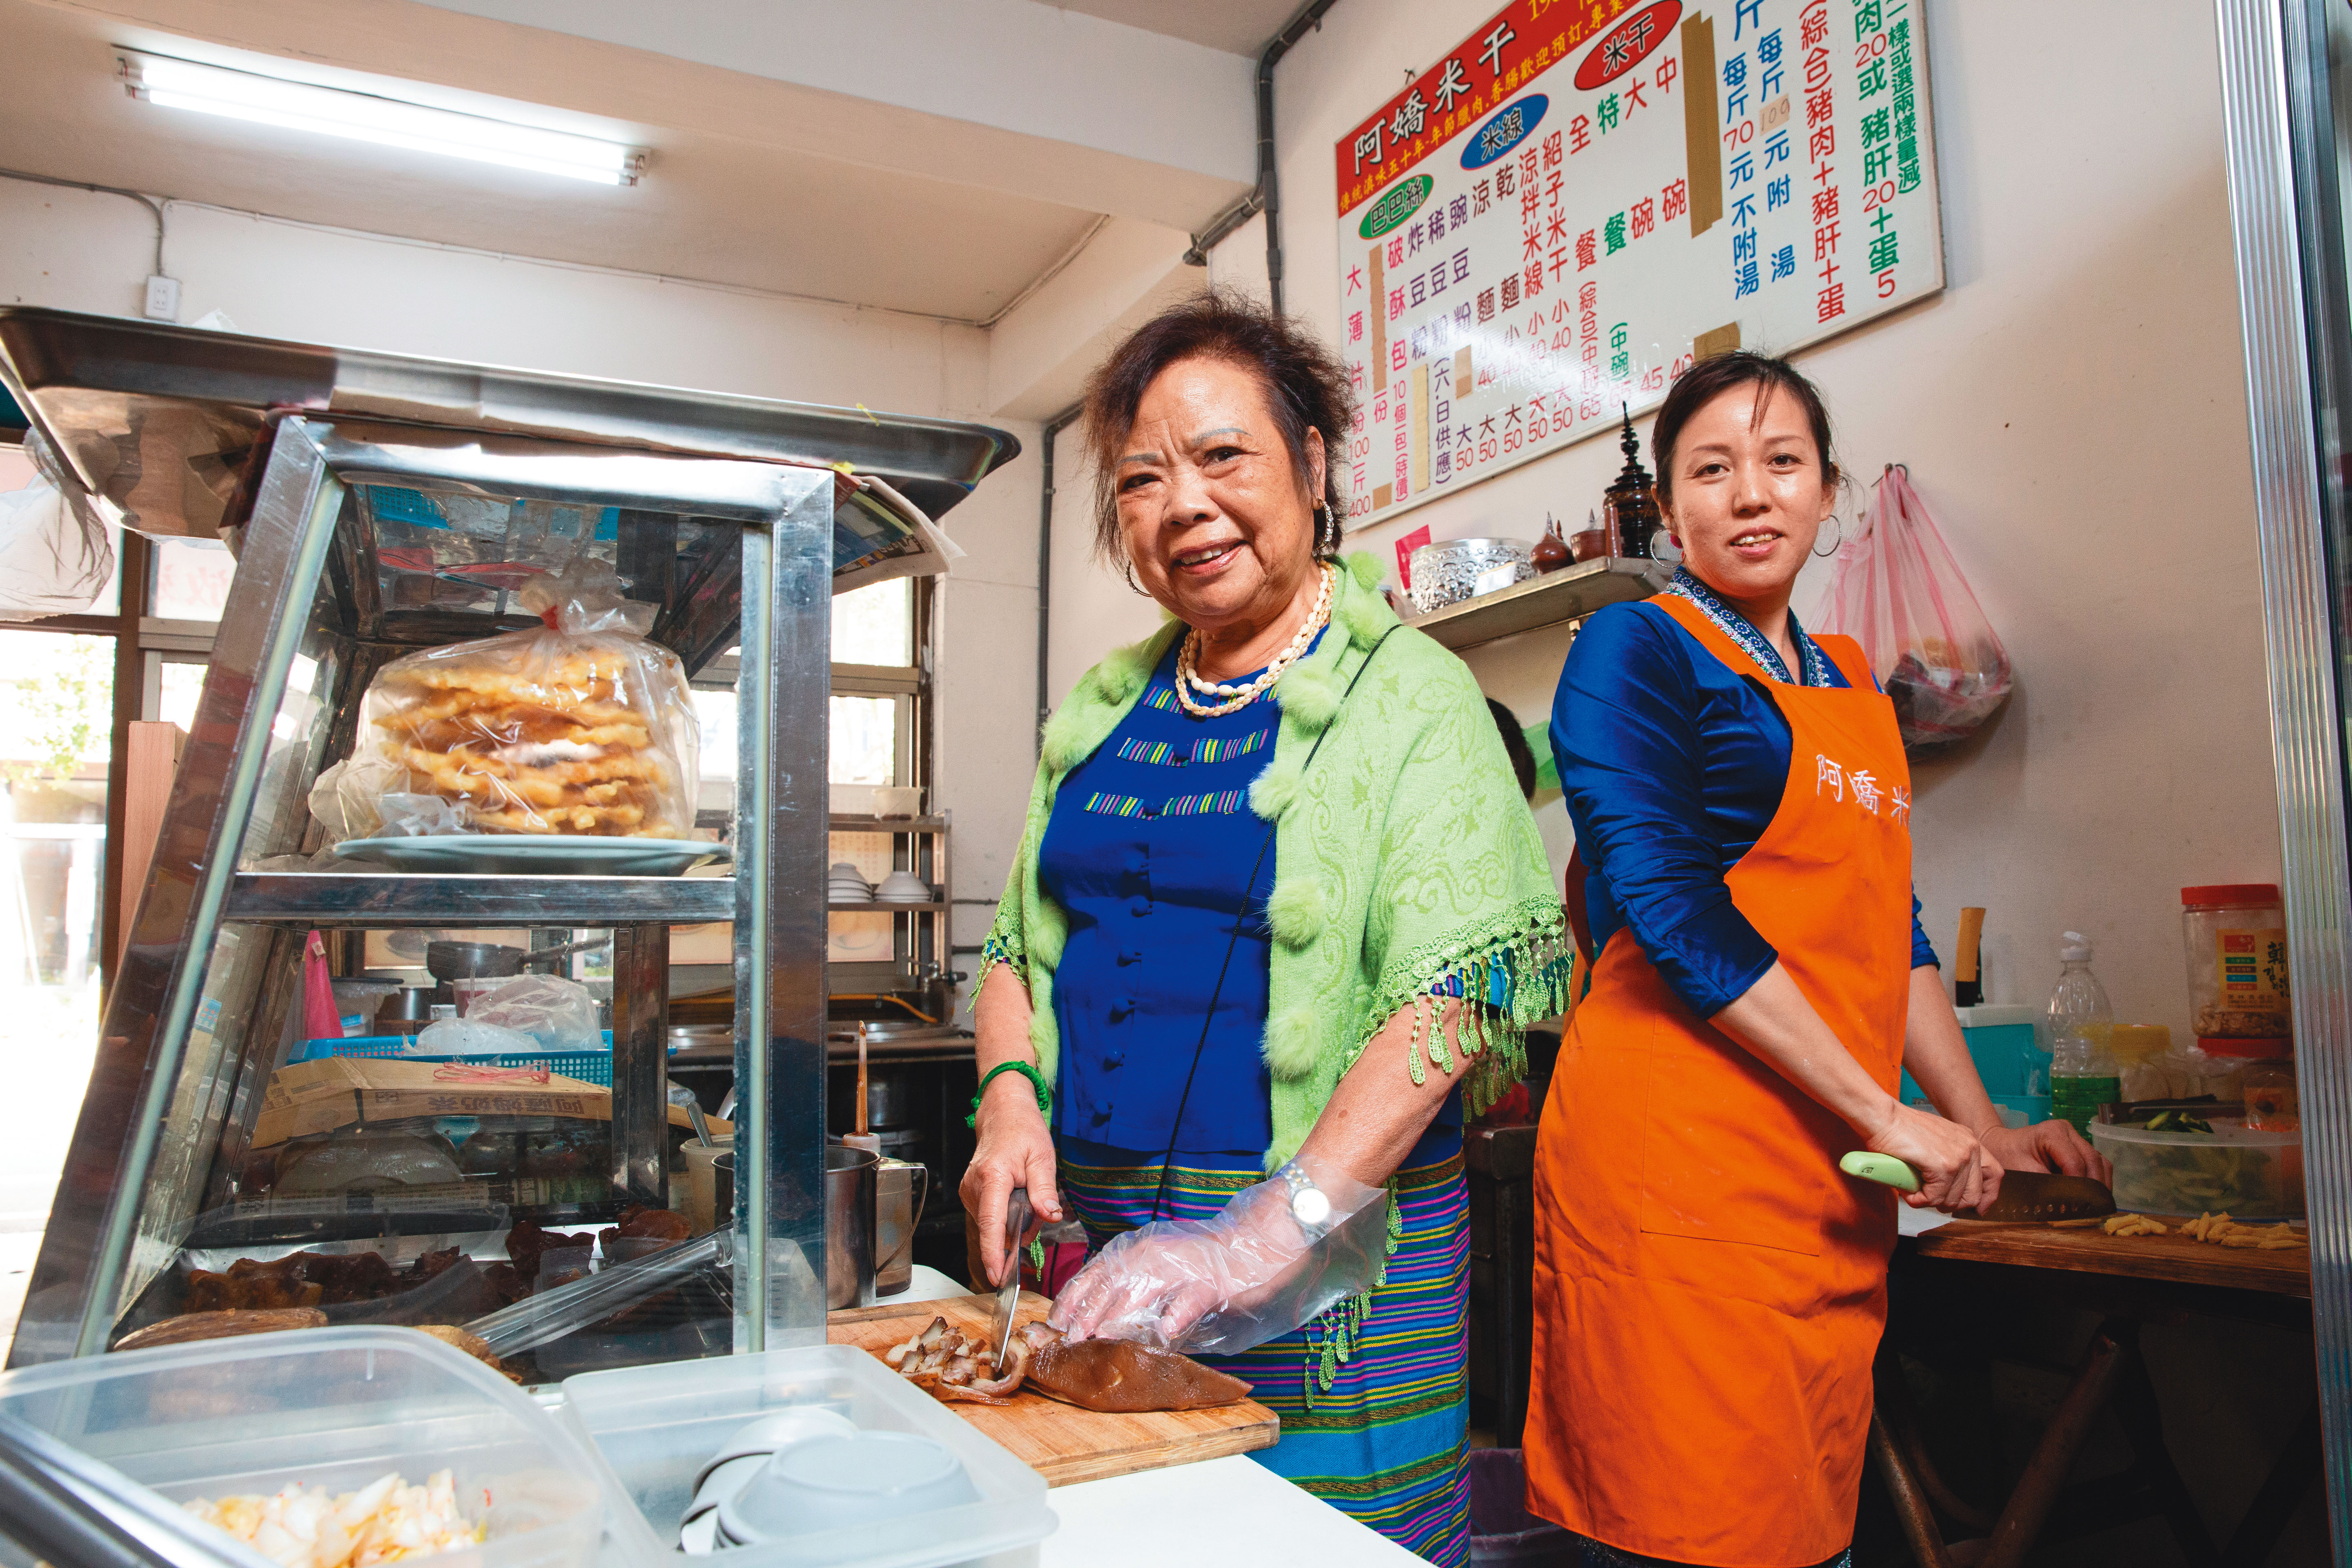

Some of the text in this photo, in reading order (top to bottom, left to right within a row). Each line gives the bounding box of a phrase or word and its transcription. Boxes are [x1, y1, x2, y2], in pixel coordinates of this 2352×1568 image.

[1603, 13, 1654, 77] 米干
[1354, 20, 1516, 176] 阿嬌米干
[1481, 107, 1523, 162] 米線
[1853, 0, 1899, 298] 肉20或豬肝20+蛋5
[1371, 176, 1425, 236] 巴巴絲
[1519, 147, 1544, 299] 涼拌米線
[1388, 235, 1408, 372] 破酥包
[1816, 754, 1909, 828] 阿嬌米
